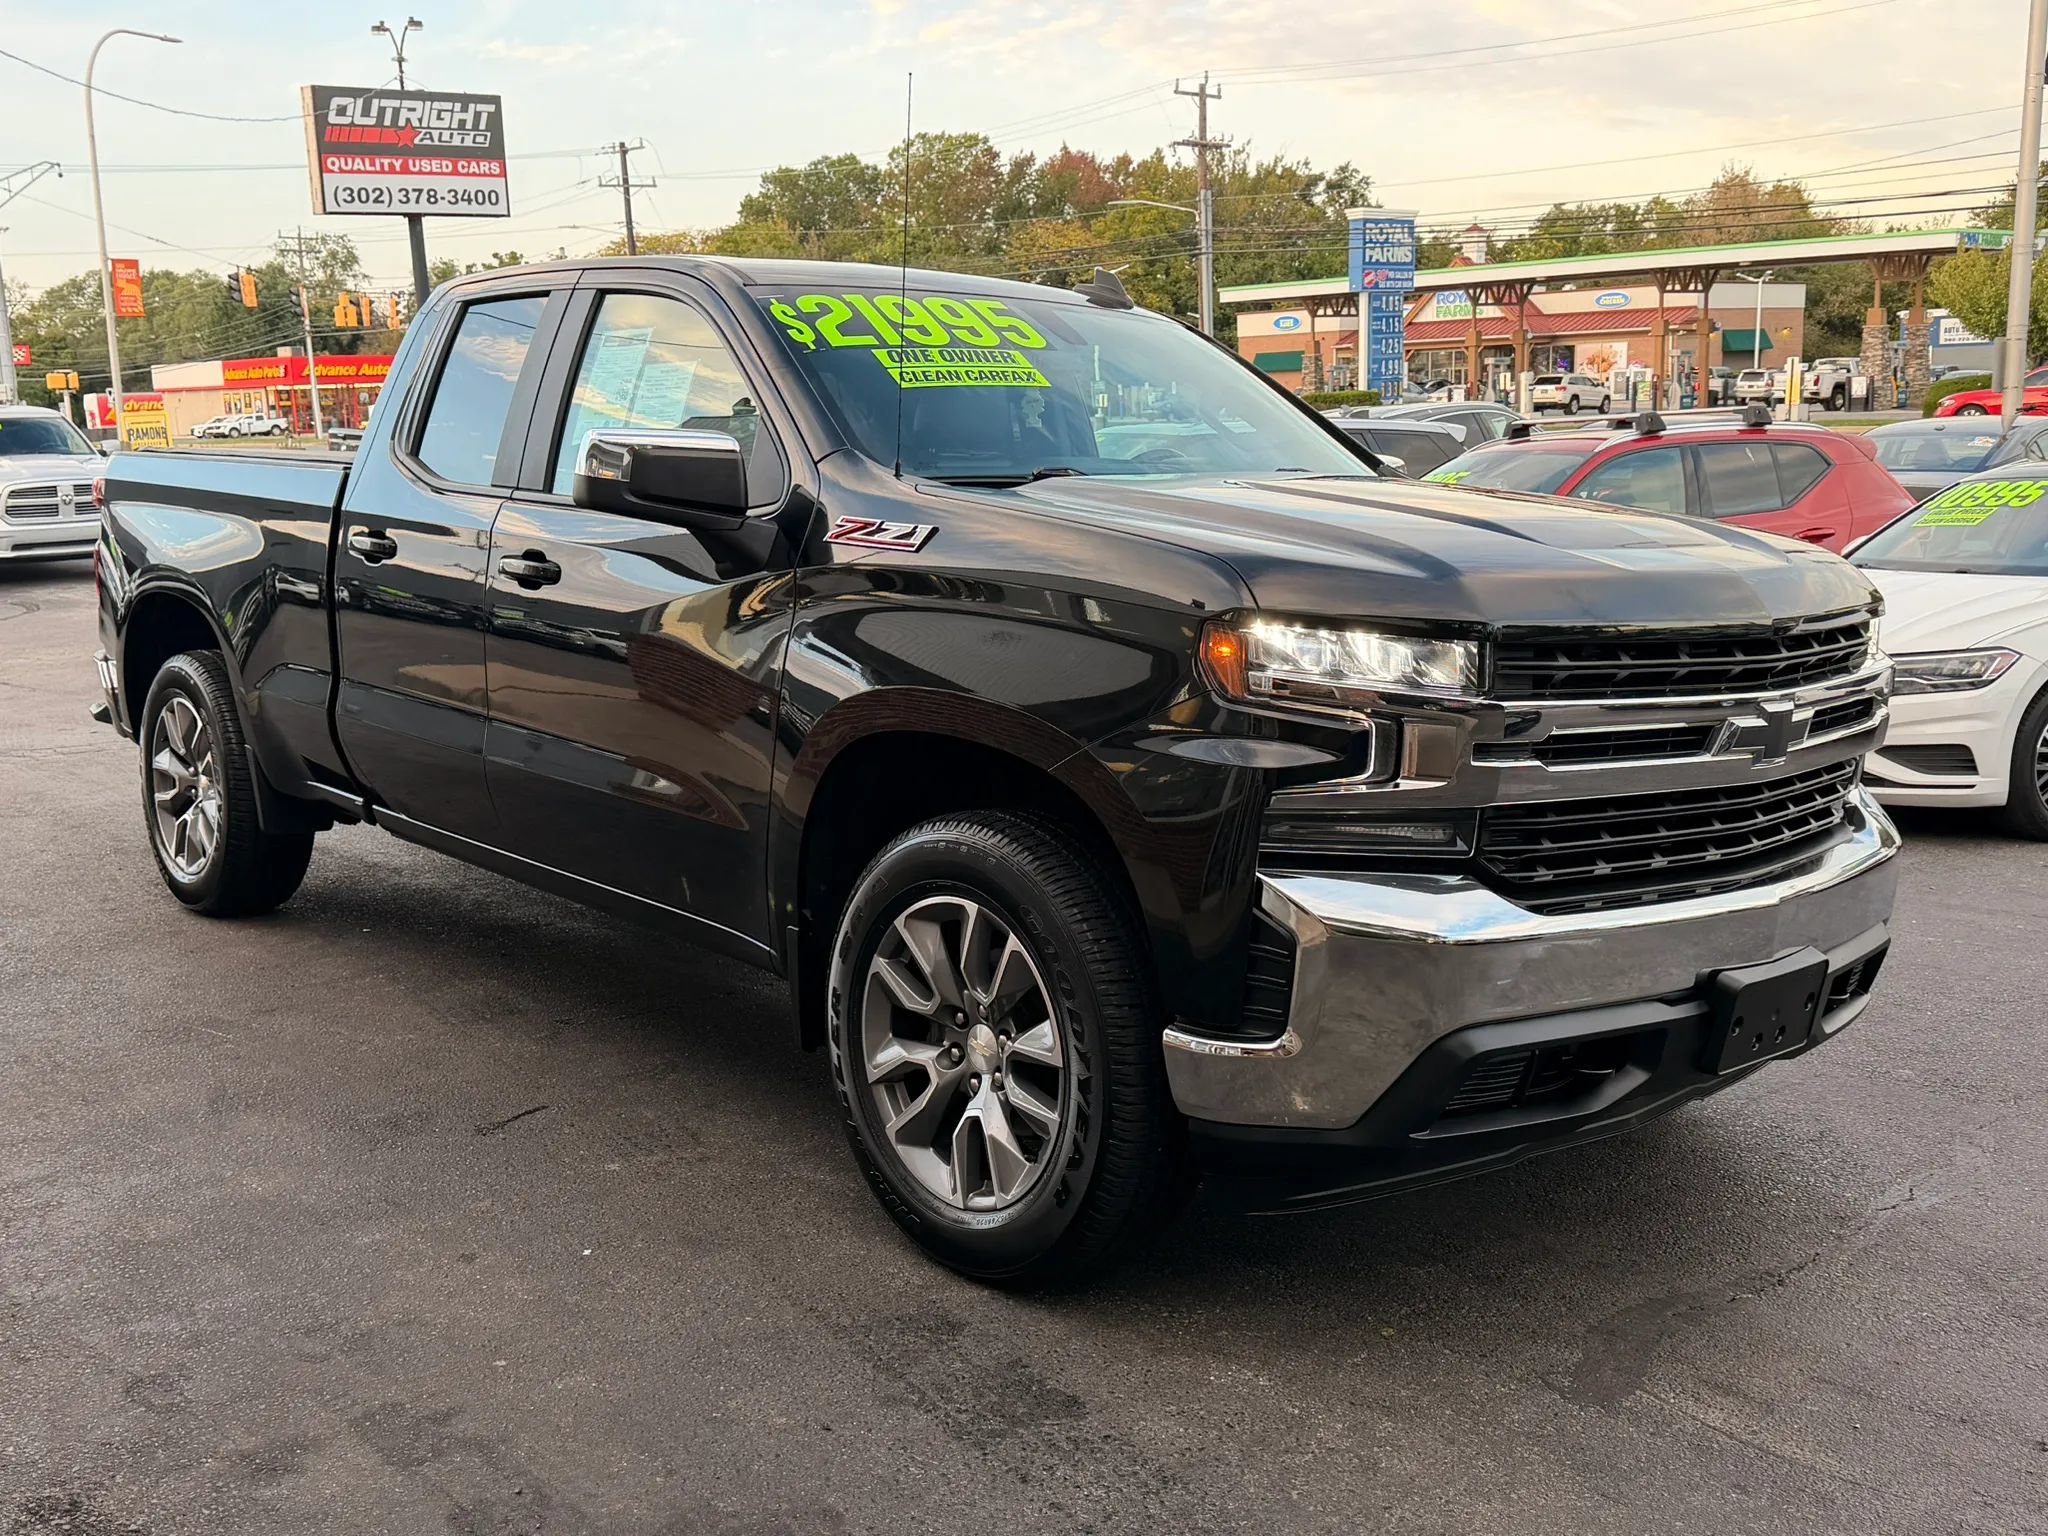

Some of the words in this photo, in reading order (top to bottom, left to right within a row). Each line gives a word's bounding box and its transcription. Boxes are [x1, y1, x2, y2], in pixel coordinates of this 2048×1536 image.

[327, 96, 496, 130] OUTRIGHT
[418, 131, 489, 145] AUTO
[326, 157, 402, 172] QUALITY
[408, 158, 453, 173] USED
[457, 160, 501, 174] CARS
[333, 185, 393, 208] (302)
[398, 187, 500, 207] 378-3400
[1365, 223, 1412, 242] ROYAL
[1365, 243, 1412, 262] FARMS
[1436, 291, 1468, 305] ROY
[769, 294, 1047, 349] $21995
[886, 349, 937, 364] ONE
[939, 349, 1018, 364] OWNER
[301, 363, 357, 376] Advance
[901, 369, 963, 383] CLEAN
[964, 369, 1038, 383] CARFAX
[823, 515, 939, 553] Z71
